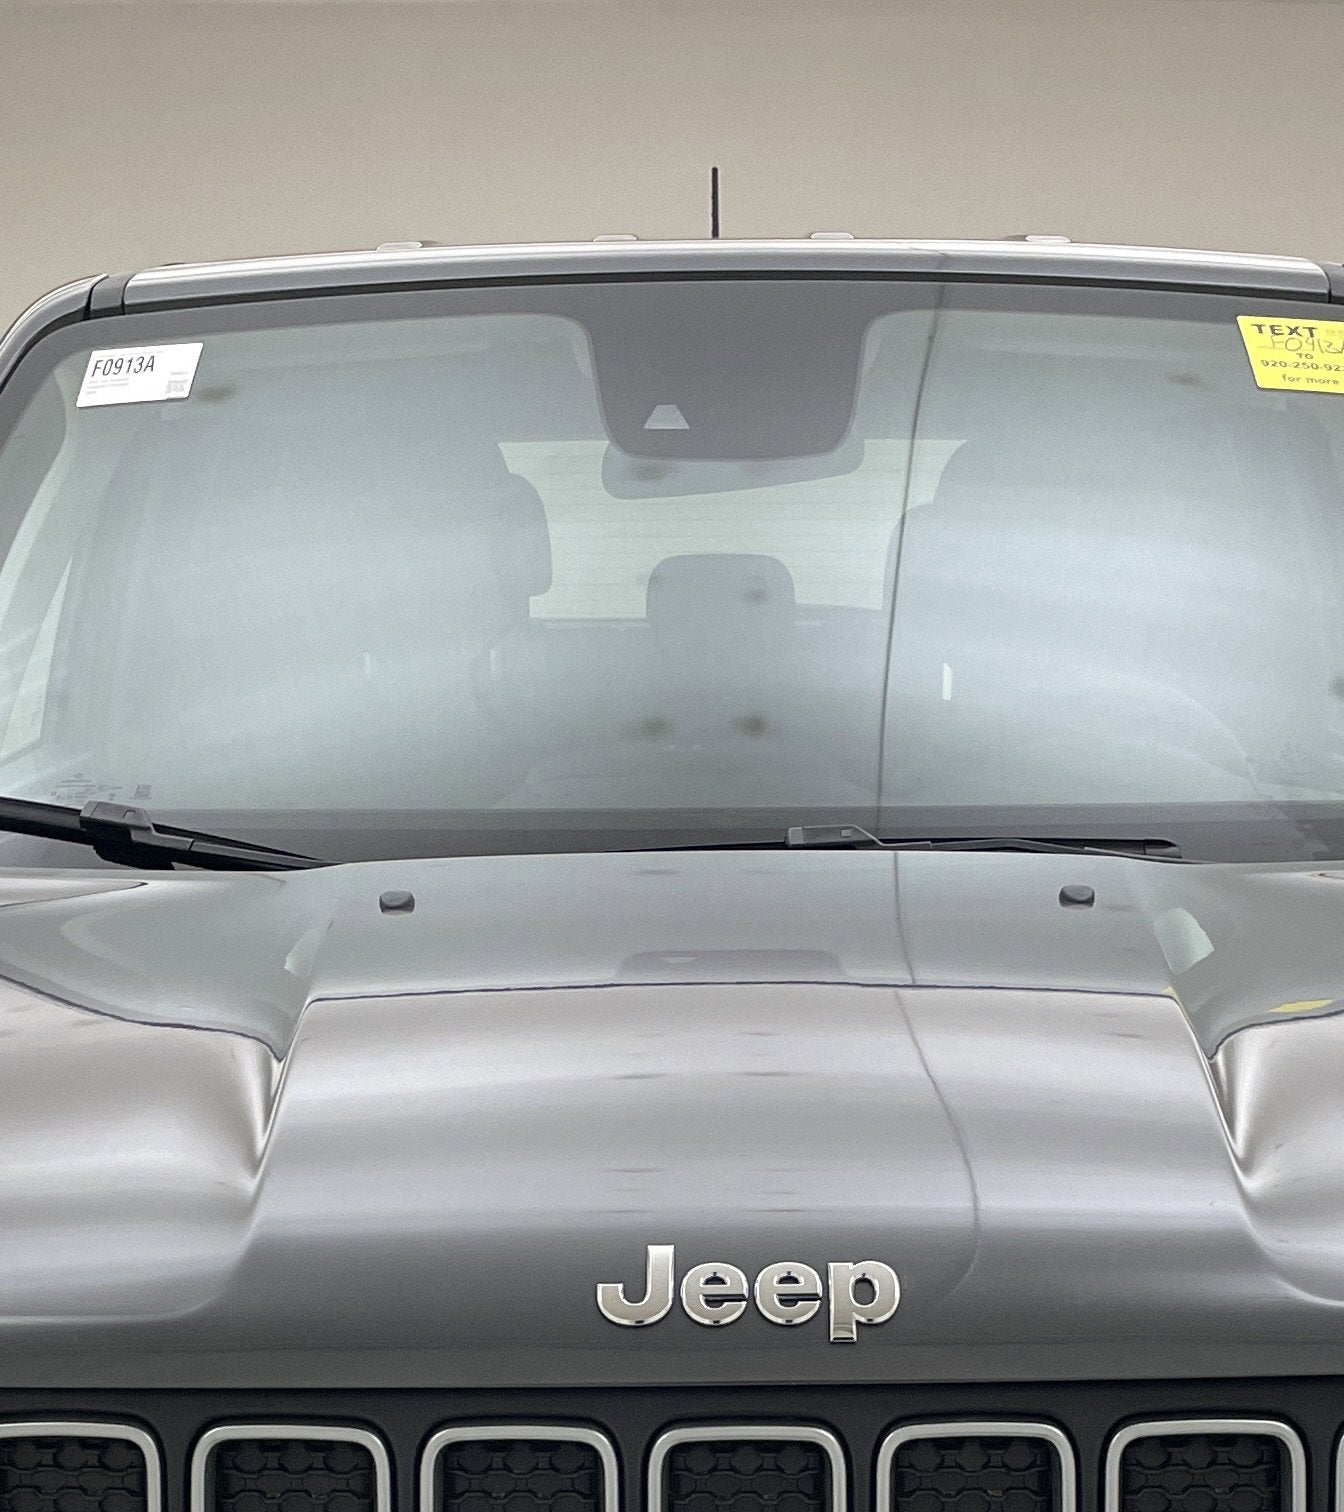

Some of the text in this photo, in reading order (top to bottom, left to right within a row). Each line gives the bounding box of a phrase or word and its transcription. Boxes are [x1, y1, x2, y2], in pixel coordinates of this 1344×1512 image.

[1251, 324, 1317, 338] TEXT
[90, 355, 155, 377] F0913A
[1282, 373, 1301, 382] for
[1306, 377, 1339, 385] more
[596, 1245, 901, 1342] Jeep
